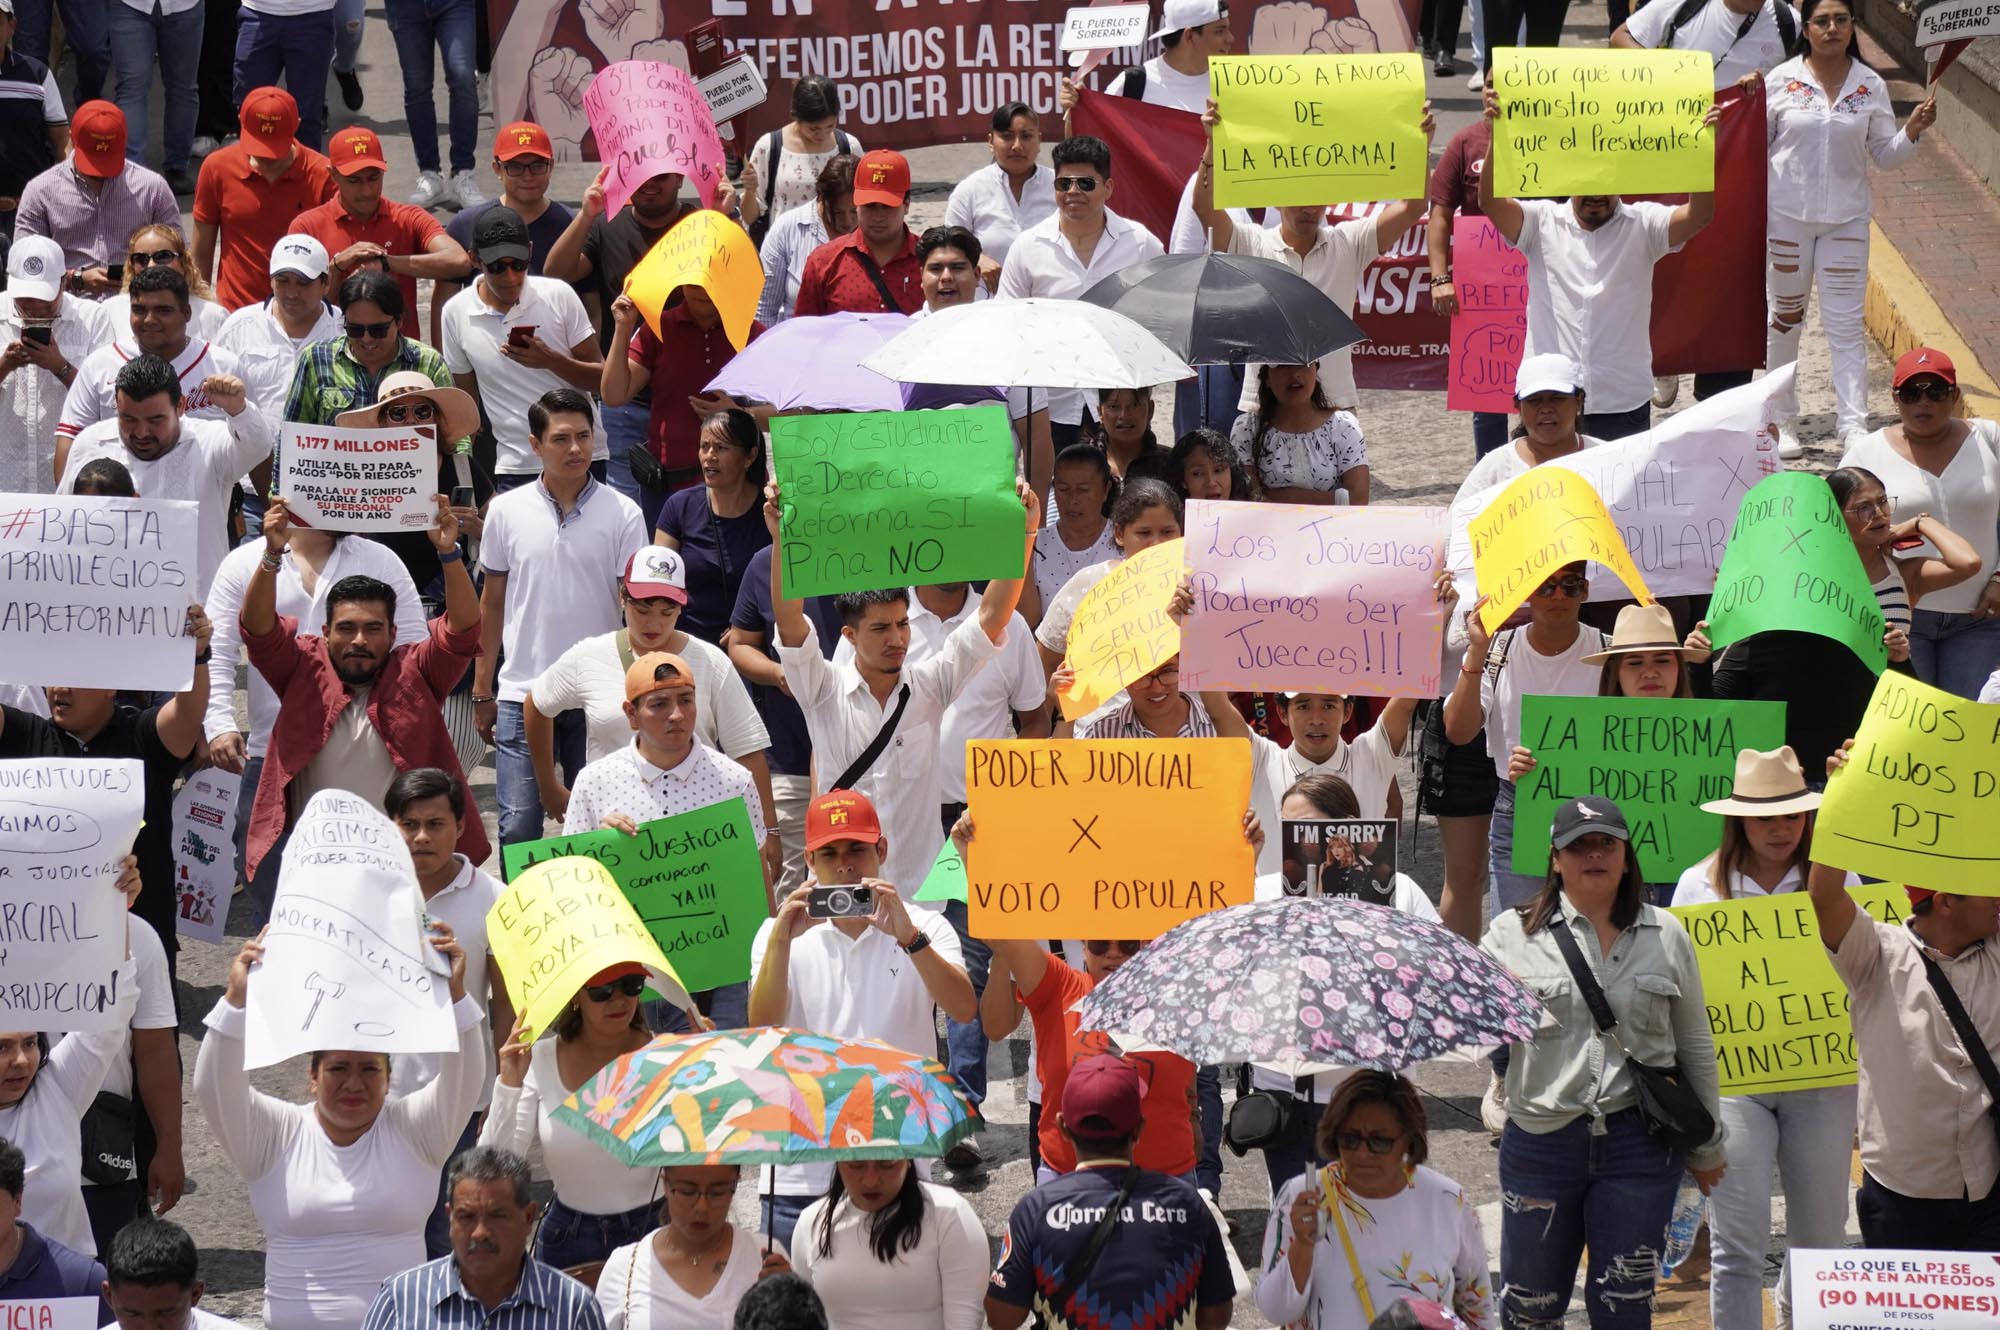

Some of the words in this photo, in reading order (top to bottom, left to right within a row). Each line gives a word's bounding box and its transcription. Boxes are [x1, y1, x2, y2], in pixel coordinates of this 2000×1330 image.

[1071, 20, 1082, 30] EL
[1087, 18, 1125, 29] PUEBLO
[1128, 17, 1140, 26] ES
[1923, 16, 1935, 27] EL
[1940, 6, 1982, 22] PUEBLO
[1986, 4, 2000, 15] ES
[1930, 17, 1990, 35] SOBERANO
[955, 24, 999, 68] LA
[1077, 28, 1130, 39] SOBERANO
[705, 81, 731, 100] PUEBLO
[732, 73, 751, 88] PONE
[1211, 61, 1301, 97] ¡TODOS
[1316, 66, 1330, 87] A
[1336, 61, 1413, 84] FAVOR
[1621, 65, 1654, 86] un
[712, 94, 735, 110] PUEBLO
[735, 84, 754, 98] QUITA
[837, 74, 948, 125] PODER
[1507, 91, 1600, 120] ministro
[1611, 98, 1665, 124] gana
[1294, 100, 1325, 127] DE
[1222, 148, 1256, 171] LA
[1268, 141, 1396, 170] REFORMA!
[1513, 132, 1548, 157] que
[1560, 127, 1577, 151] el
[872, 173, 886, 183] PT
[296, 435, 329, 450] 1,177
[334, 438, 420, 453] MILLONES
[289, 466, 327, 478] PAGOS
[298, 459, 341, 471] UTILIZA
[344, 462, 358, 472] EL
[361, 463, 376, 472] PJ
[379, 461, 413, 471] PARA
[815, 461, 939, 495] Derecho
[1717, 455, 1752, 500] X
[293, 484, 323, 494] PARA
[326, 486, 339, 495] LA
[342, 487, 358, 495] UV
[361, 486, 417, 496] SIGNIFICA
[306, 493, 358, 504] PAGARLE
[371, 495, 404, 504] TODO
[316, 501, 332, 510] SU
[334, 502, 393, 511] PERSONAL
[0, 507, 163, 550] #BASTA
[322, 509, 345, 519] POR
[348, 511, 364, 519] UN
[780, 501, 915, 539] Reforma
[920, 496, 977, 531] SI
[1203, 516, 1277, 561] Los
[1780, 525, 1813, 556] X
[1, 550, 187, 589] PRIVILEGIOS
[782, 541, 873, 589] Piña
[889, 538, 945, 576] NO
[1191, 571, 1319, 623] Podemos
[1346, 583, 1408, 626] Ser
[1712, 574, 1764, 620] VOTO
[1224, 619, 1405, 677] Jueces!!!
[1874, 683, 1966, 743] ADIOS
[1537, 715, 1579, 751] LA
[1602, 714, 1738, 761] REFORMA
[971, 746, 1069, 788] PODER
[1082, 749, 1205, 790] JUDICIAL
[1532, 766, 1576, 800] AL
[1589, 765, 1678, 804] PODER
[1973, 770, 2000, 799] D
[830, 811, 848, 826] PT
[1068, 814, 1102, 854] X
[1891, 803, 1956, 847] PJ
[639, 821, 739, 862] Justicia
[27, 862, 119, 881] JUDICIAL
[497, 890, 536, 932] EL
[975, 881, 1061, 914] VOTO
[1093, 878, 1228, 911] POPULAR
[523, 892, 616, 946] SABIO
[655, 914, 731, 954] udicial
[1774, 908, 1812, 940] LE
[520, 934, 584, 1001] APOYA
[1740, 956, 1789, 990] AL
[1046, 1201, 1135, 1232] Coroa
[1816, 1271, 1871, 1283] GASTA
[1877, 1272, 1899, 1283] EN
[1904, 1273, 1996, 1288] ANTEOJOS
[1834, 1260, 1856, 1271] LO
[1861, 1260, 1896, 1273] QUE
[1901, 1262, 1921, 1272] EL
[1926, 1262, 1946, 1274] PJ
[1951, 1263, 1971, 1275] SE
[1819, 1289, 1857, 1309] (90
[1865, 1291, 1999, 1317] MILLONES)
[1884, 1310, 1898, 1319] DE
[1901, 1311, 1935, 1321] PESOS
